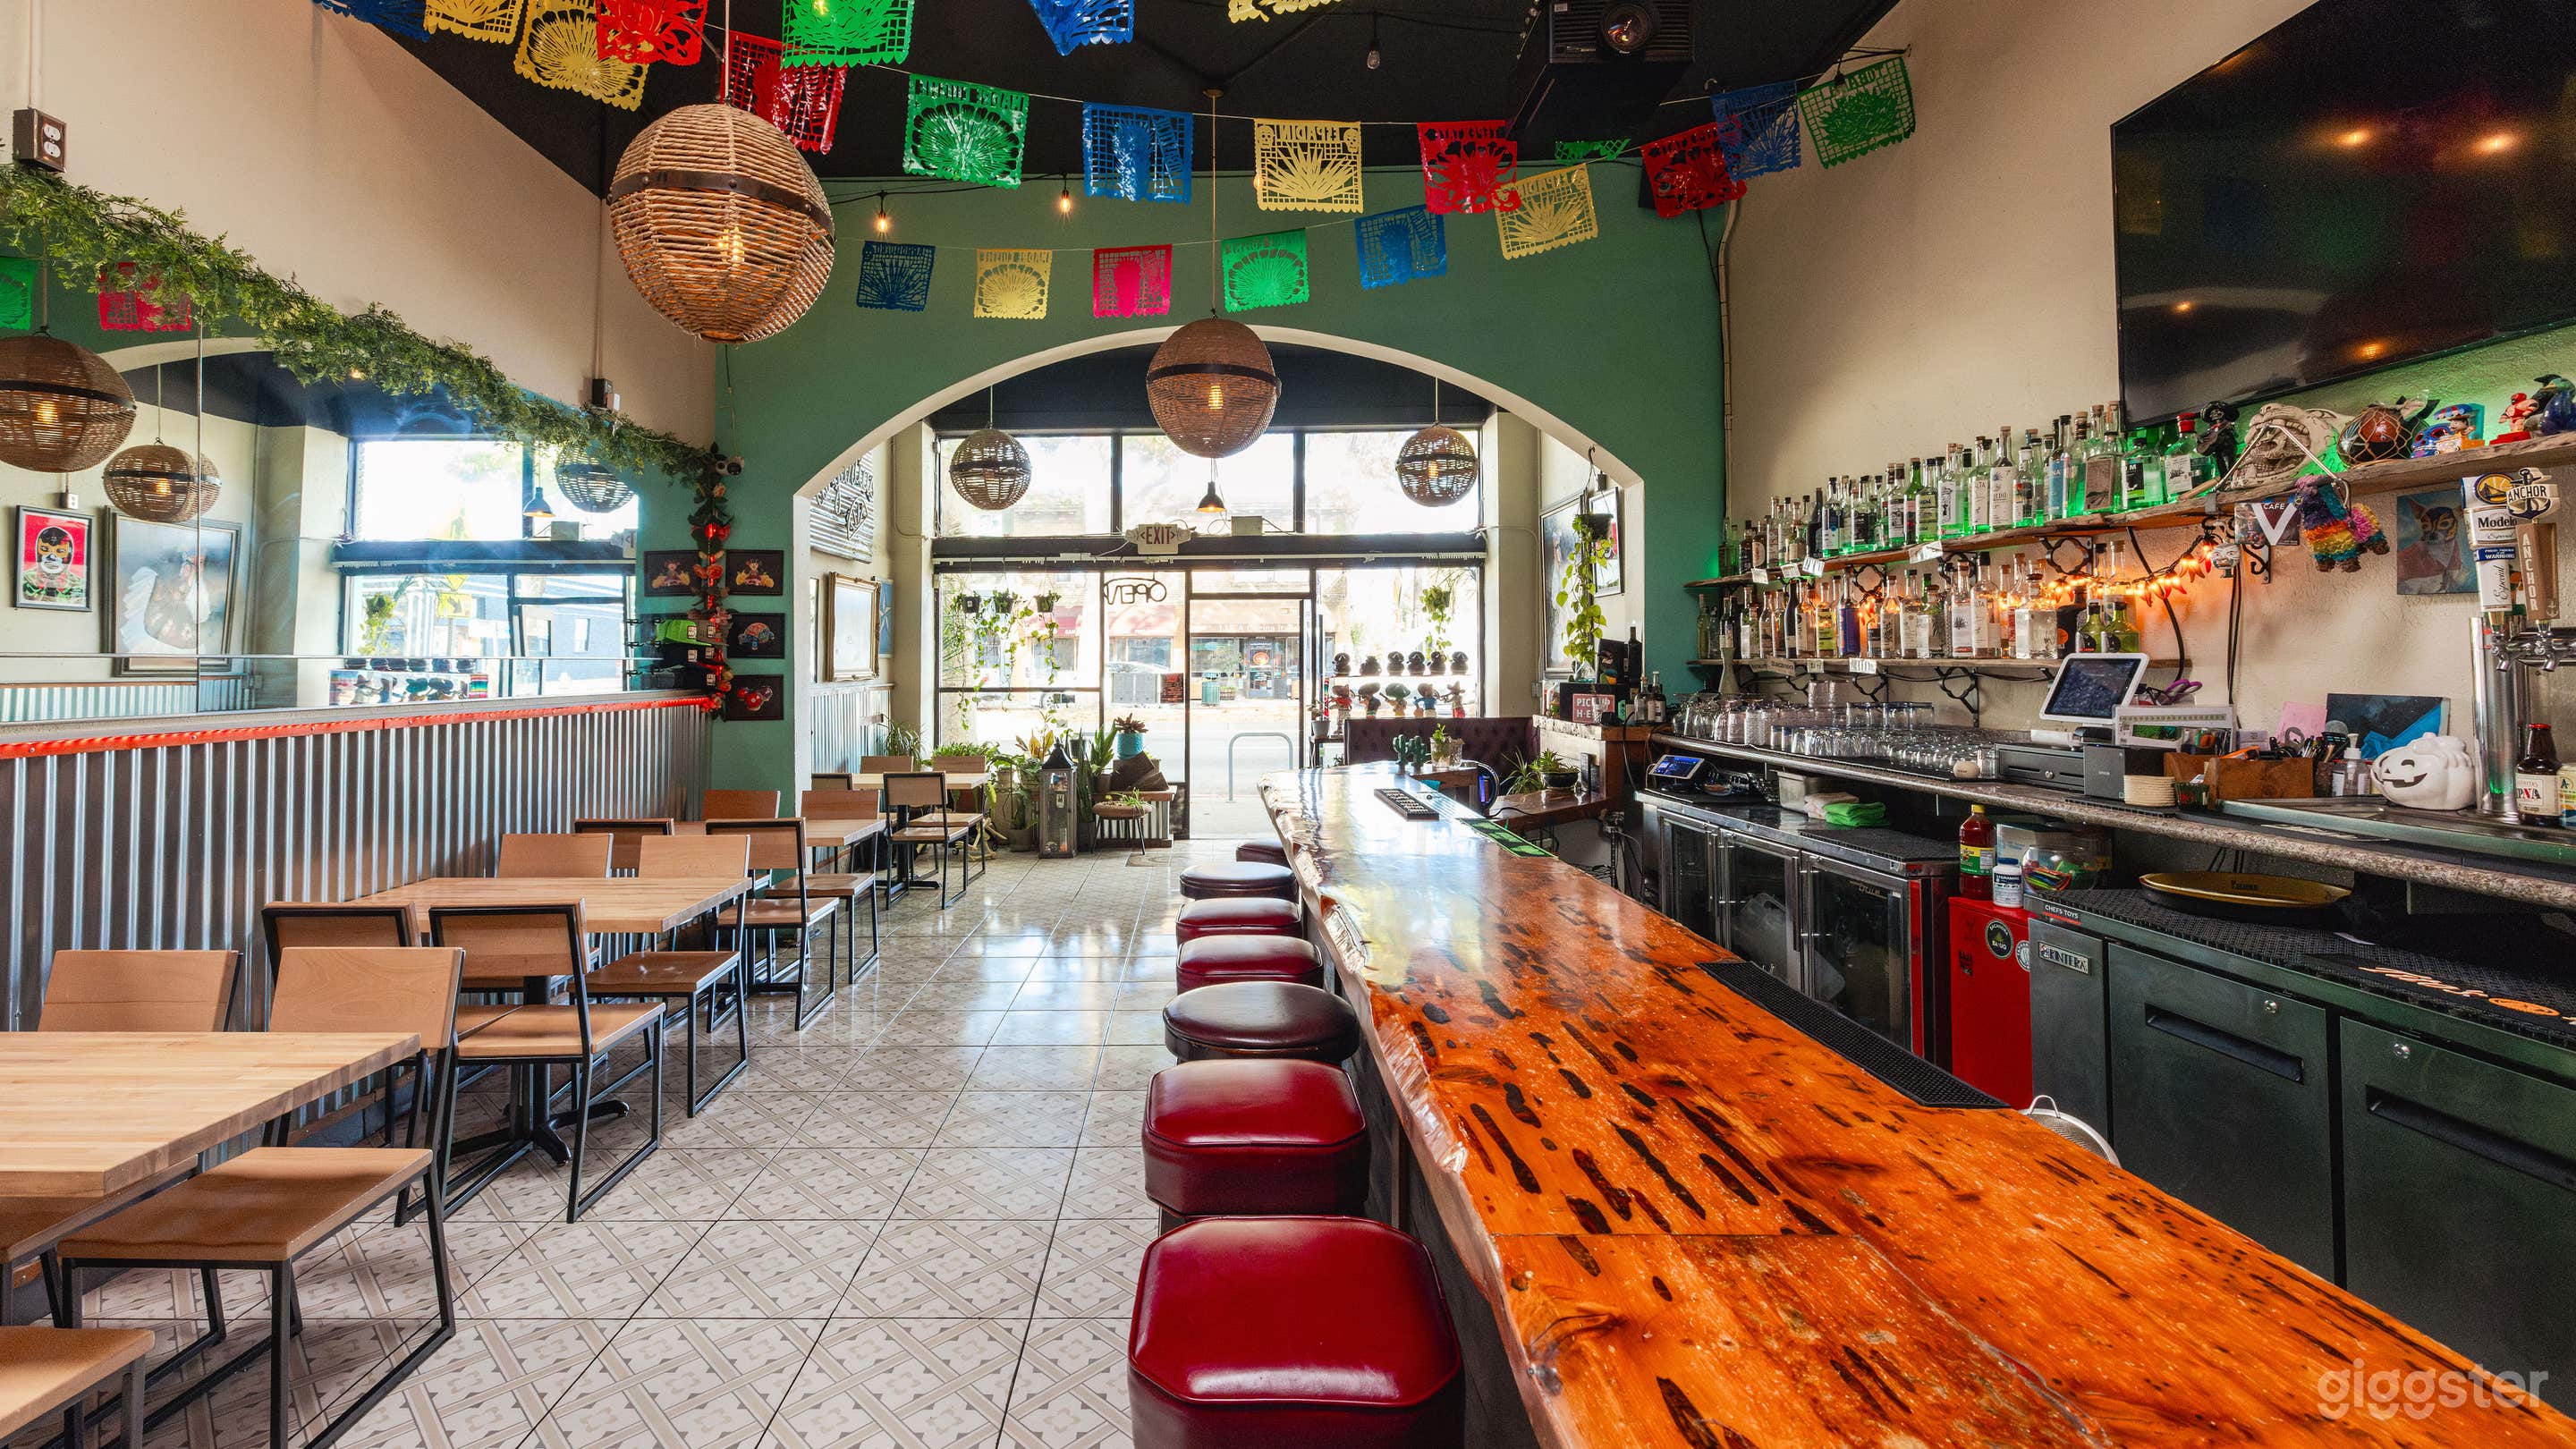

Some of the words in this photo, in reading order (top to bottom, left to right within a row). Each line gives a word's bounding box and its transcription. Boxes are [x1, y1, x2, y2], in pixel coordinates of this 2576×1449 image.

[2507, 486, 2547, 504] ANCHOR
[2478, 515, 2518, 529] Modelo
[1146, 526, 1172, 545] EXIT
[2521, 532, 2538, 611] ANCHOR
[1576, 698, 1594, 707] PIC
